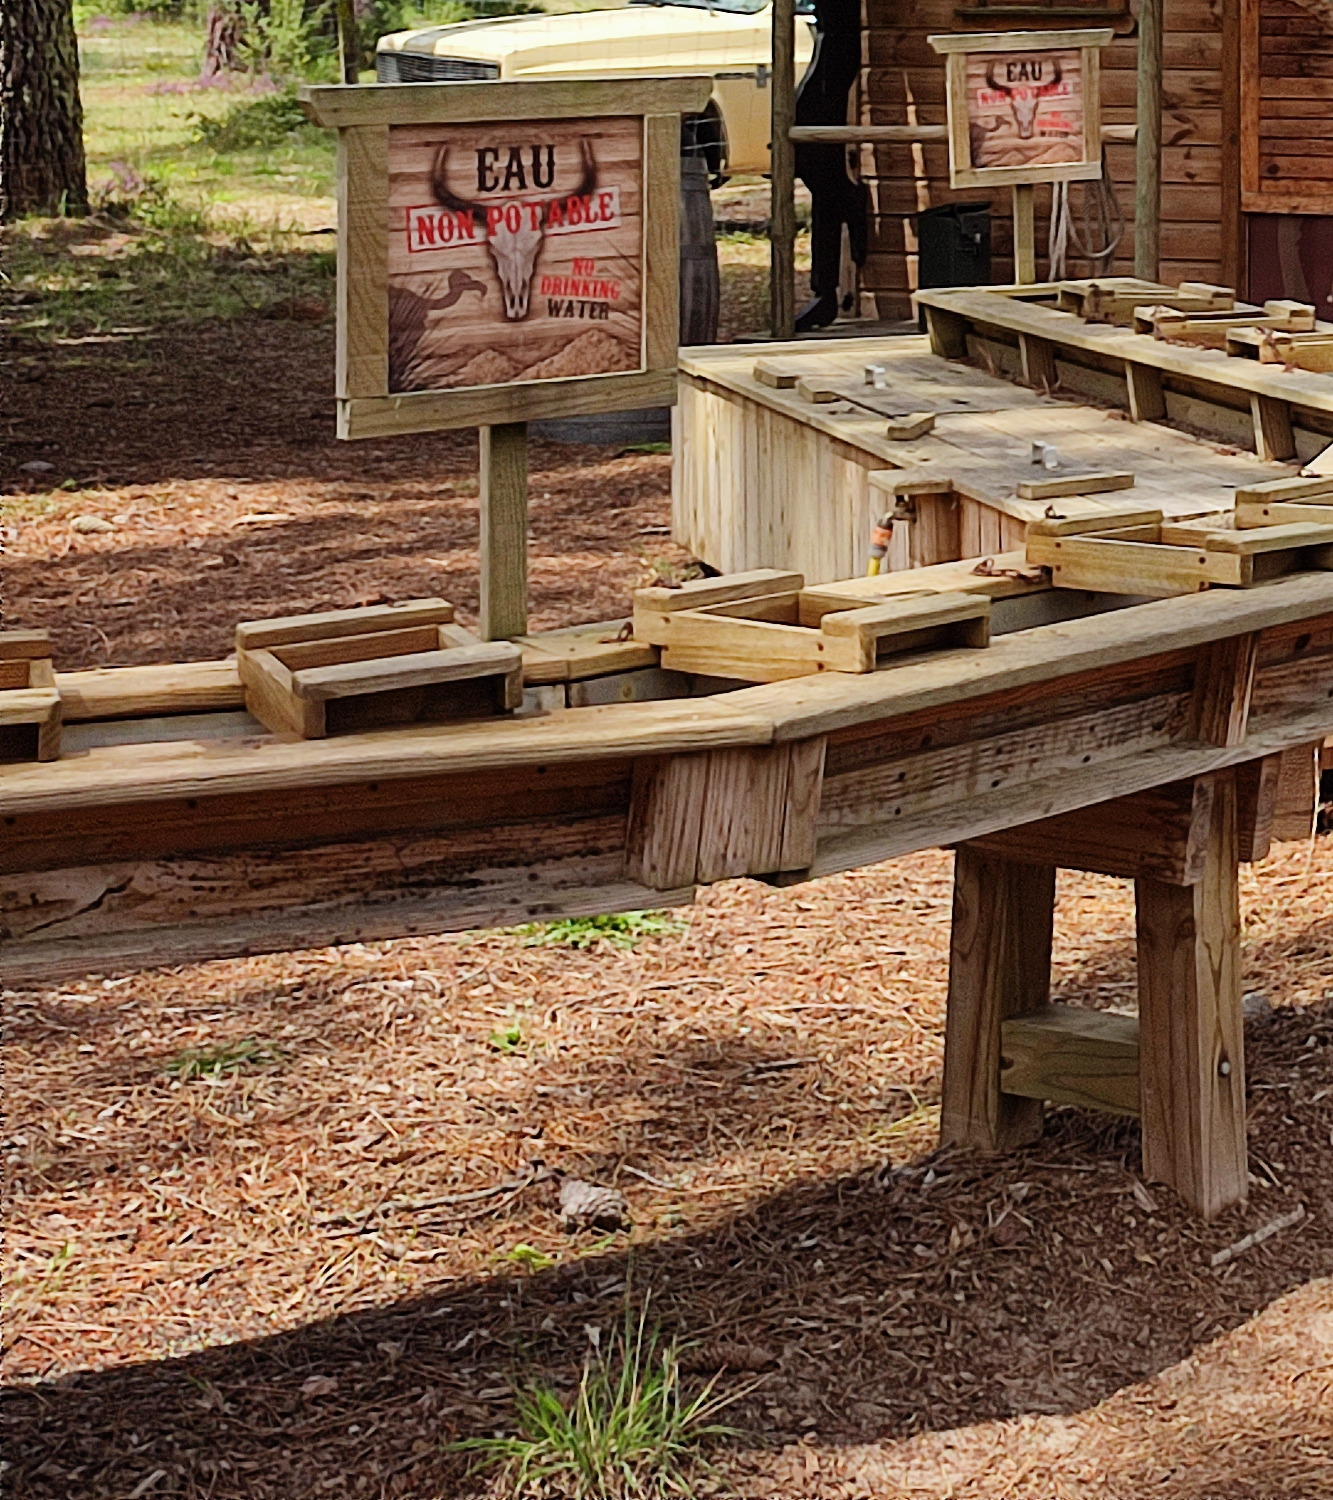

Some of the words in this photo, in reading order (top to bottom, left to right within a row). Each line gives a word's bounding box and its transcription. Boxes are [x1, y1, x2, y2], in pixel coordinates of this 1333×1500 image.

[1006, 61, 1042, 82] EAU
[476, 144, 556, 192] EAU
[415, 208, 475, 245] NON
[487, 191, 616, 237] POTABLE
[572, 256, 595, 277] NO
[540, 274, 621, 300] DRINKING
[547, 298, 610, 320] WATER
